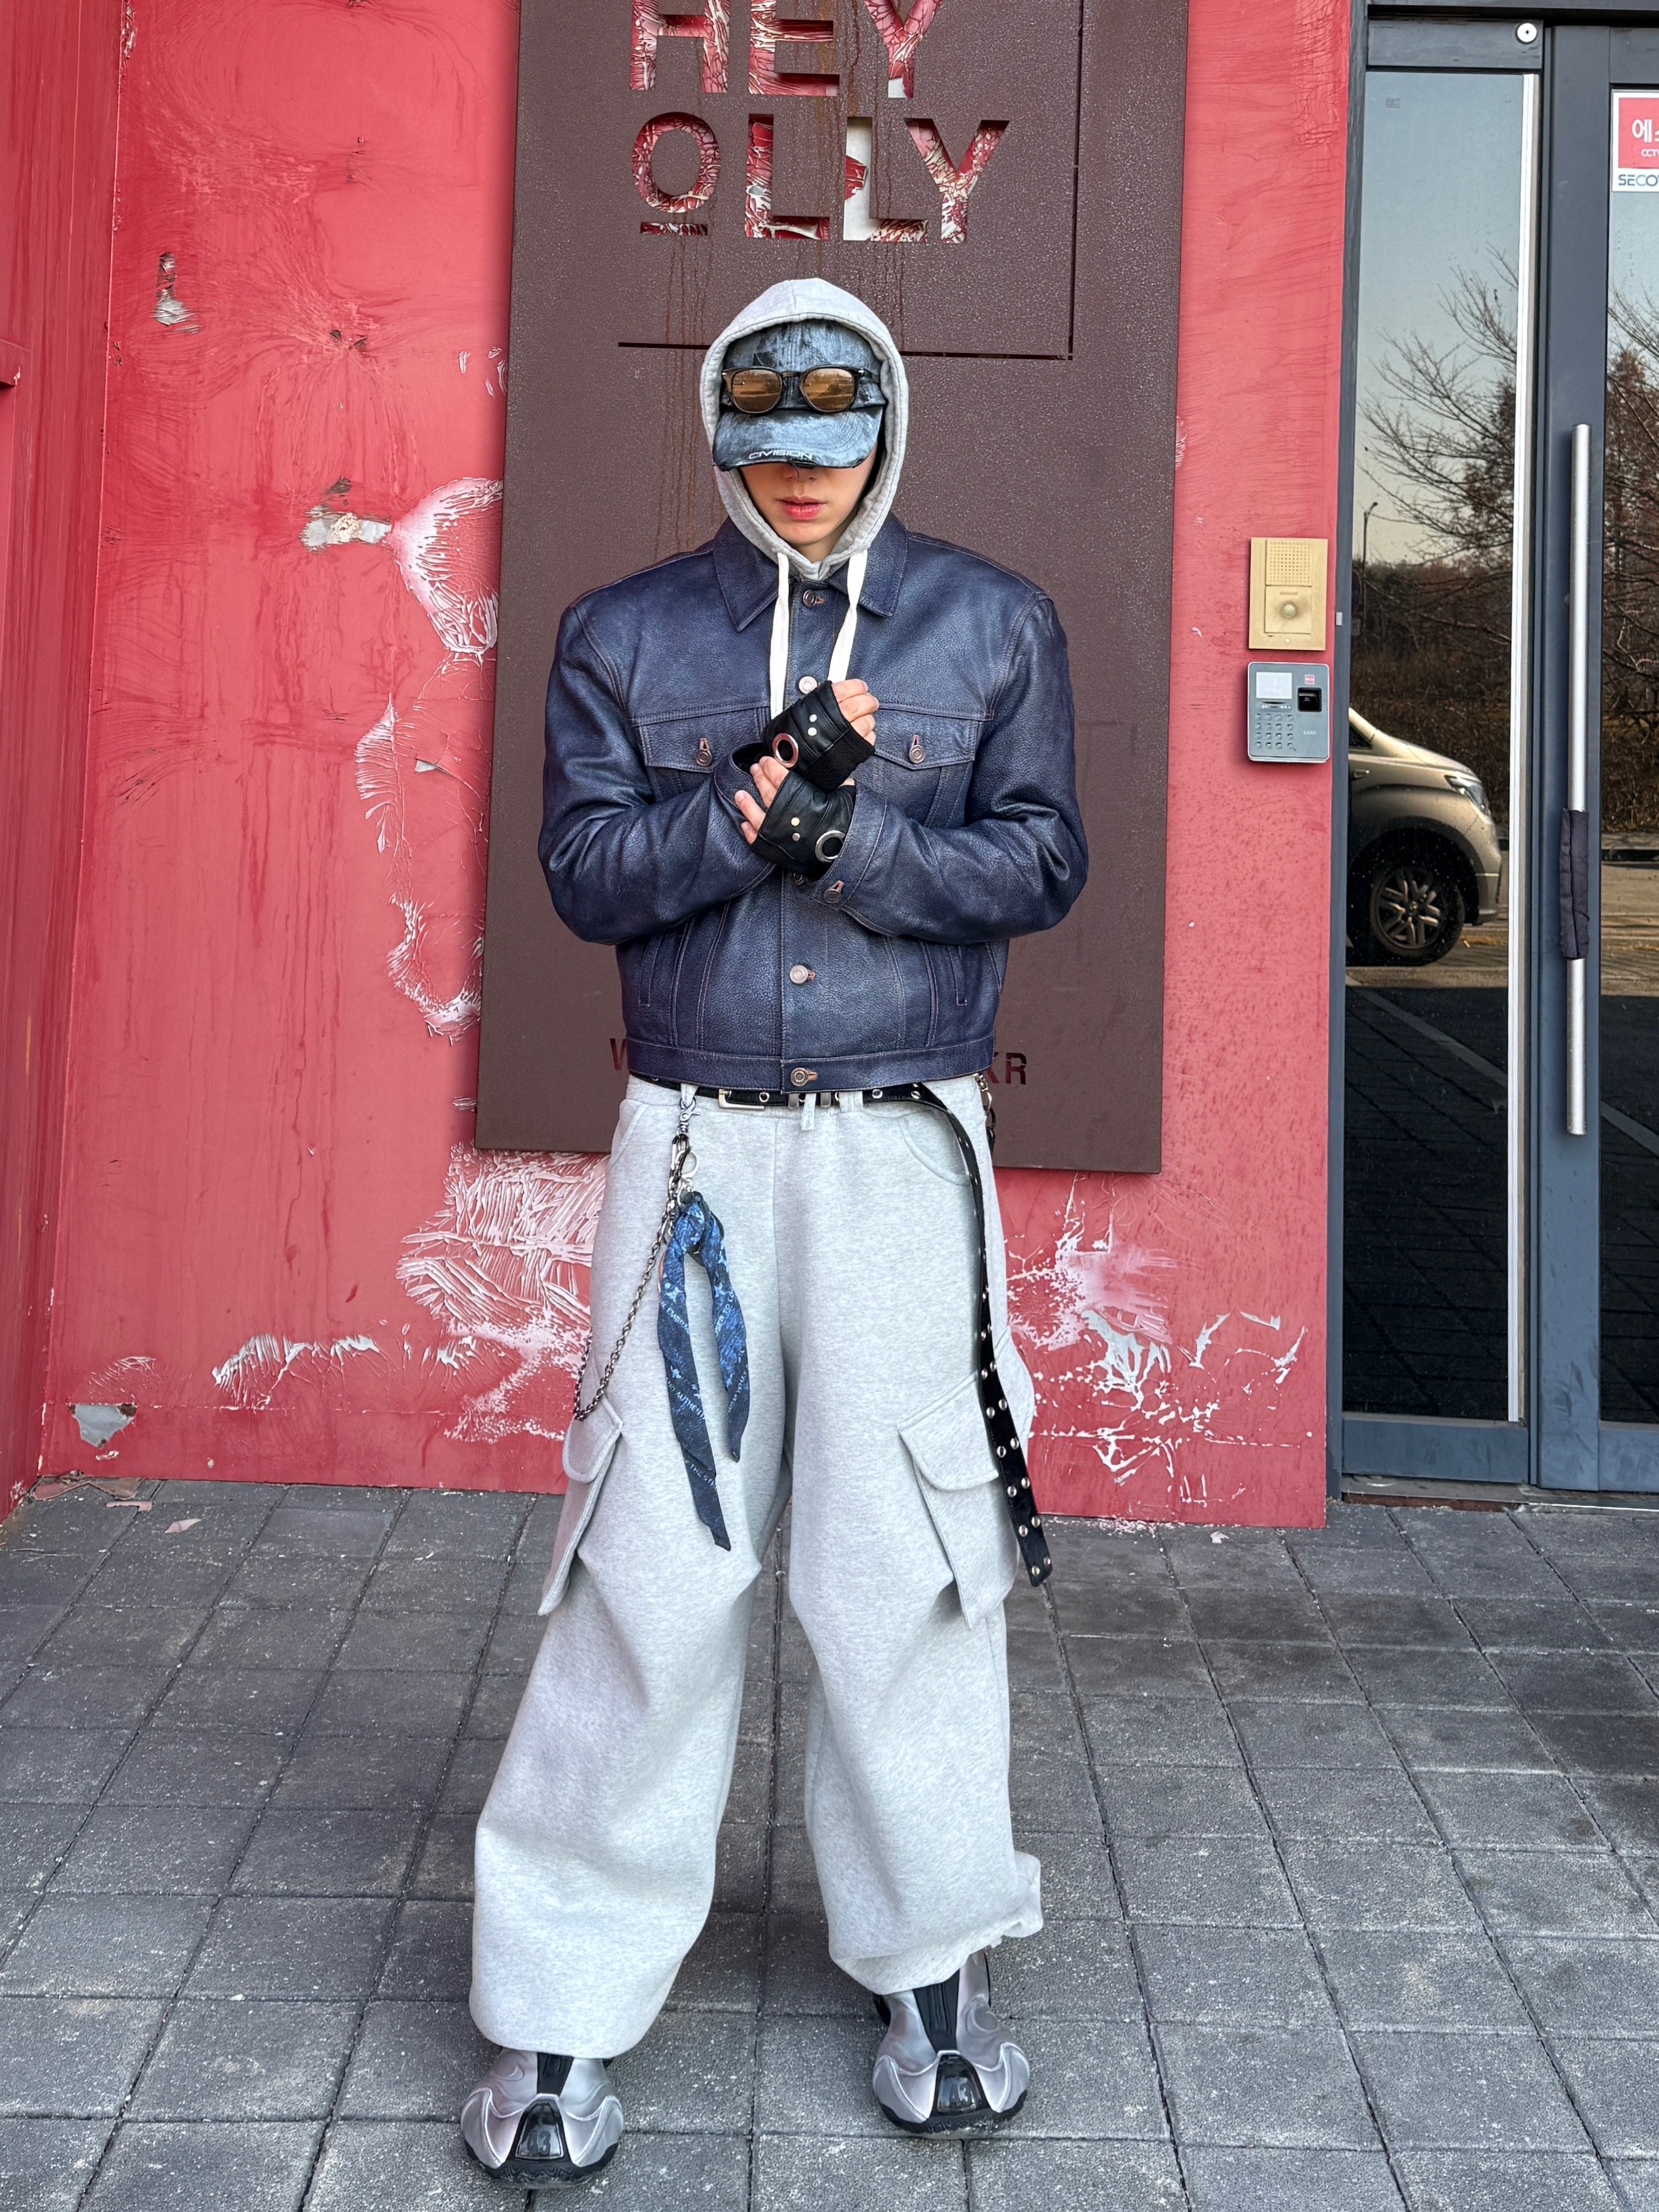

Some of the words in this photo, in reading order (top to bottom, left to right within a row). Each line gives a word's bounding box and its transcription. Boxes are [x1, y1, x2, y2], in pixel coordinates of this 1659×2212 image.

[629, 0, 940, 98] HEY
[1631, 118, 1659, 143] 에
[631, 112, 1009, 243] OLLY
[1618, 174, 1659, 187] SECO
